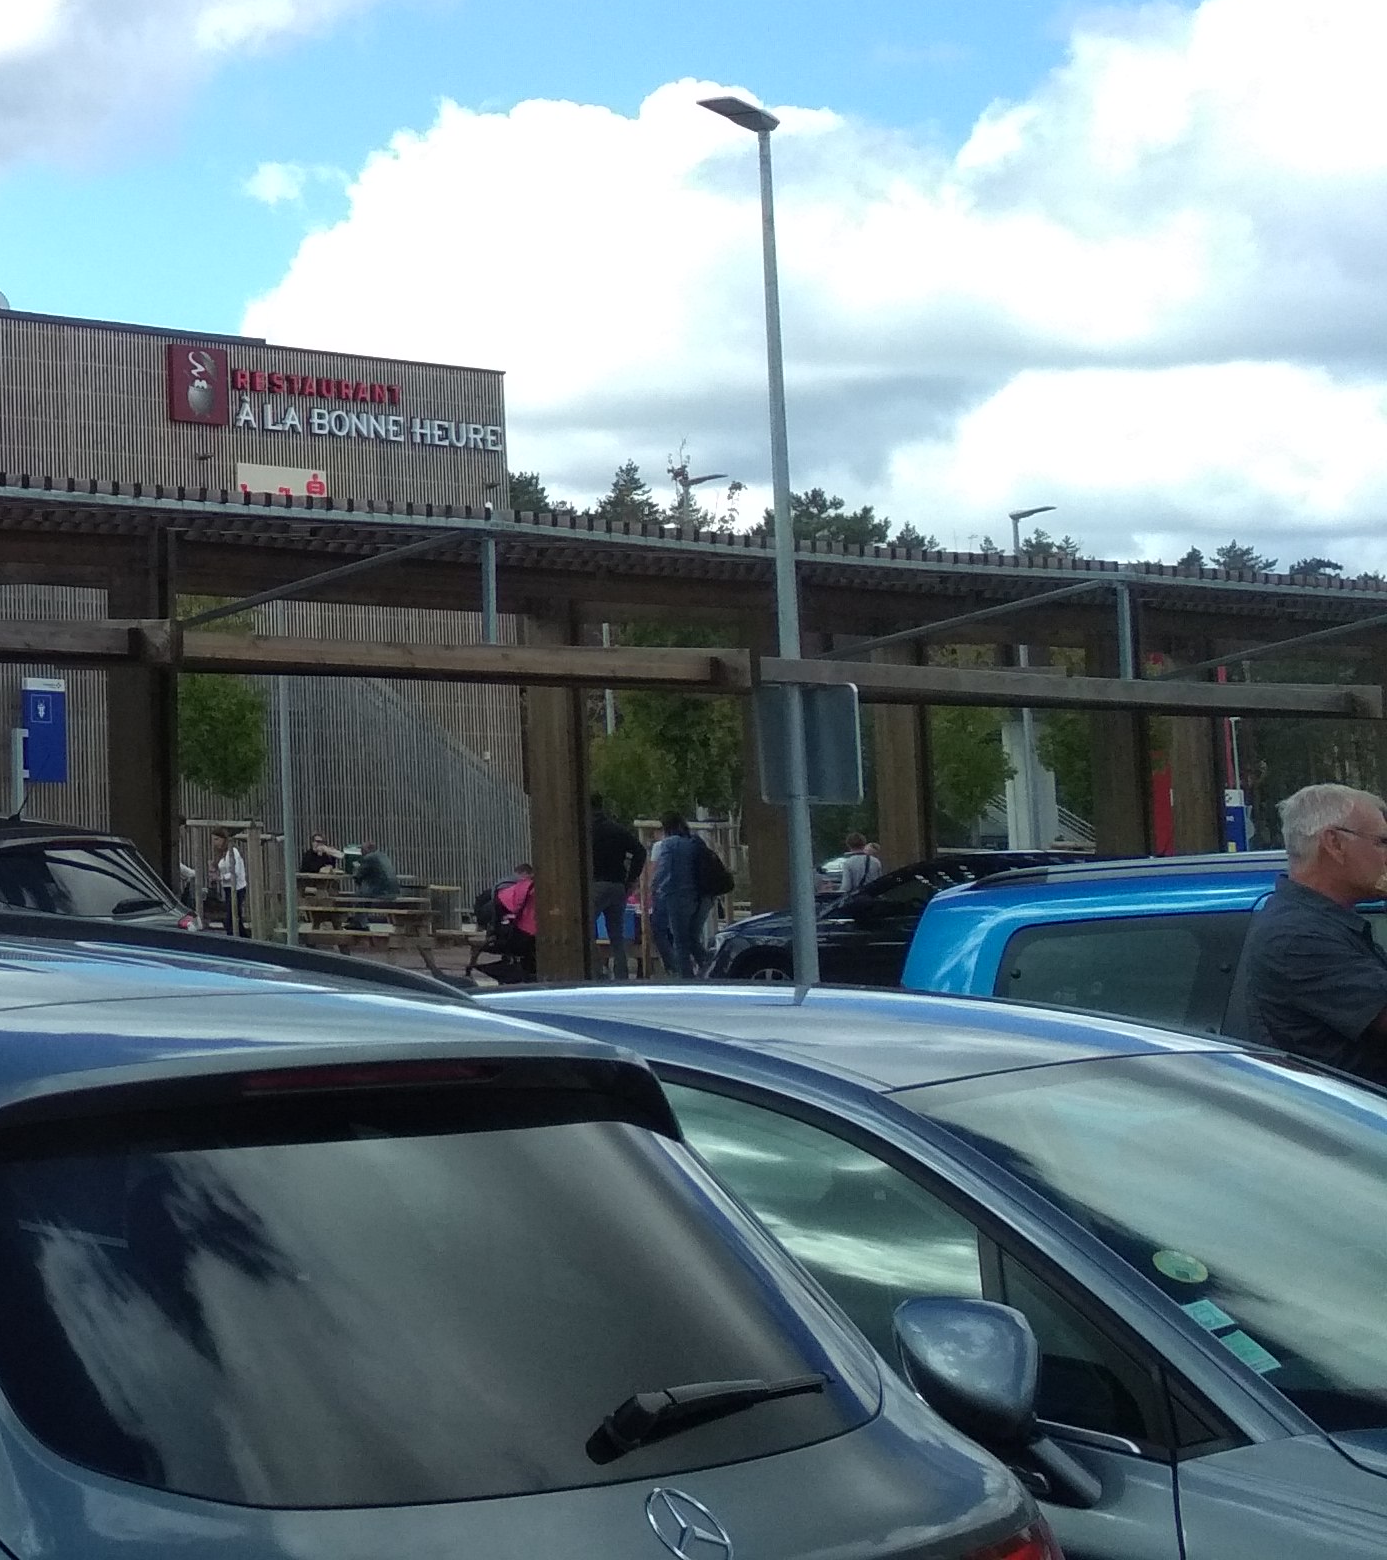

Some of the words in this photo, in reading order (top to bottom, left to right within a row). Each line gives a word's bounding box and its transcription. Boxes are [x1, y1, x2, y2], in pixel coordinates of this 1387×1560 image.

[232, 369, 403, 406] RESTAURANT
[263, 403, 303, 433] LA
[309, 407, 405, 443] BONNE
[411, 417, 503, 452] HEURE
